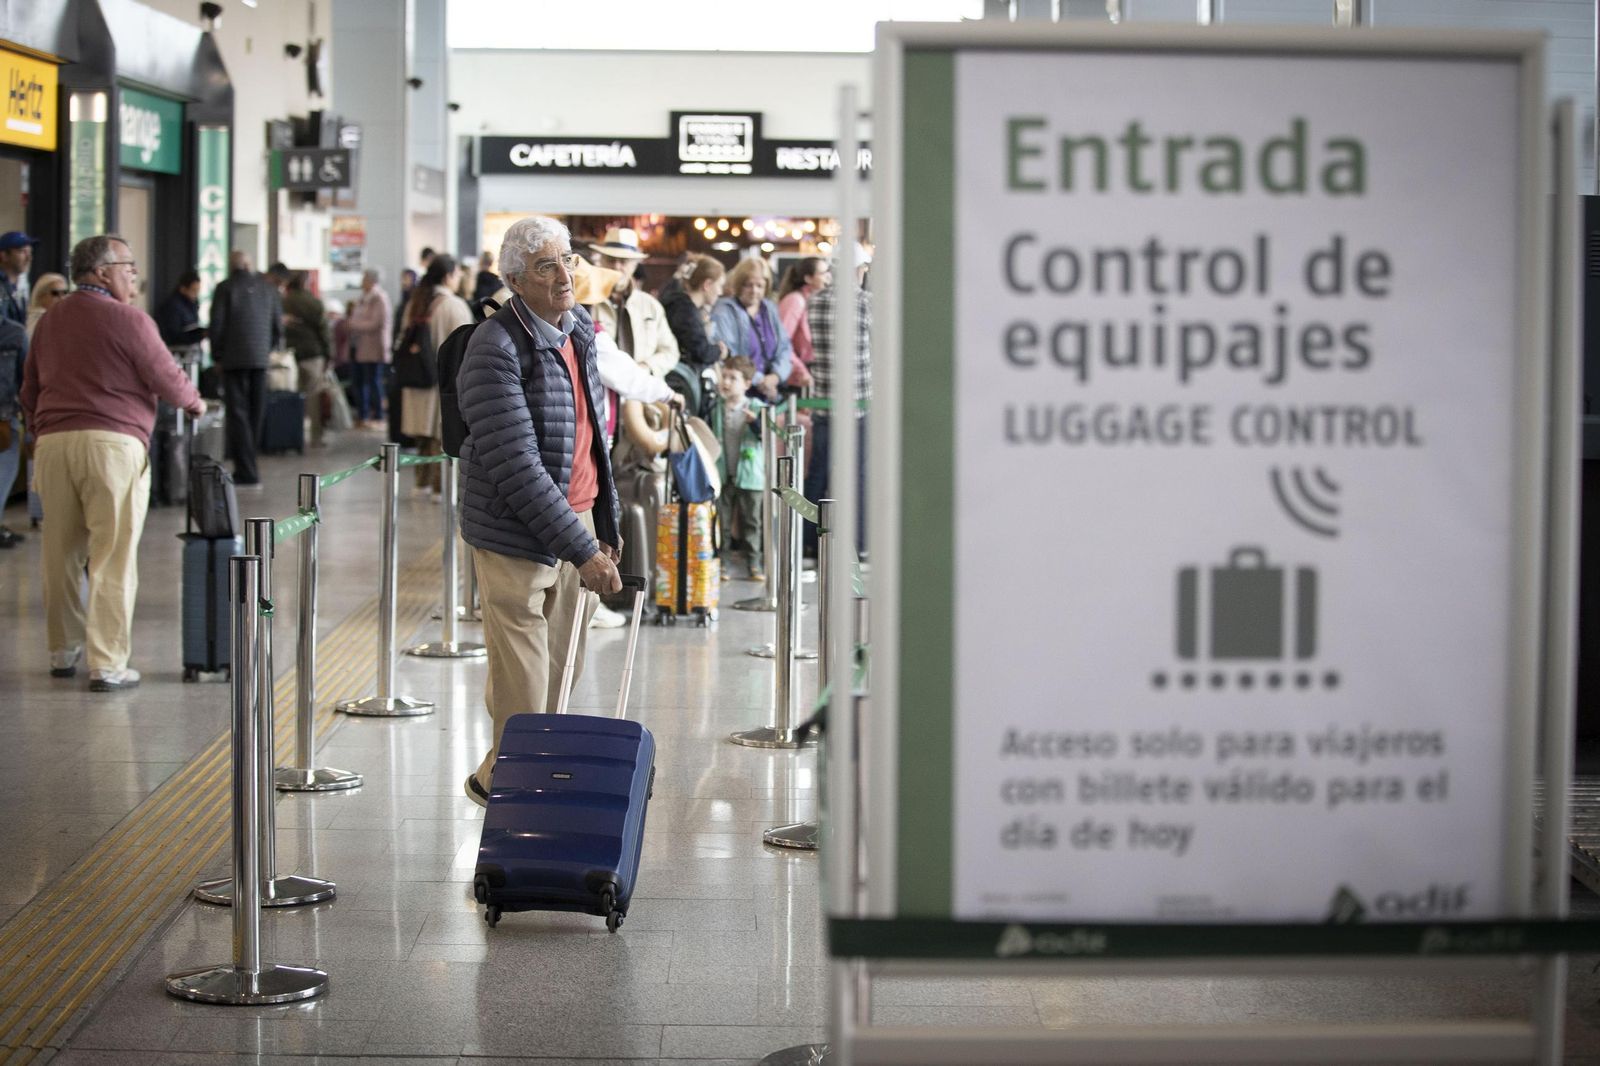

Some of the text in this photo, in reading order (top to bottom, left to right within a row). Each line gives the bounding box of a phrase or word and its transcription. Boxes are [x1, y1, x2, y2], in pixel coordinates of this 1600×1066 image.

[8, 67, 43, 119] Hertz
[509, 140, 637, 167] CAFETERÍA
[1007, 116, 1367, 195] Entrada
[1004, 232, 1393, 298] Control de
[1003, 303, 1372, 386] equipajes
[1004, 404, 1424, 447] LUGGAGE CONTROL
[1001, 725, 1446, 763] Acceso solo para viajeros
[1001, 769, 1450, 810] con billete válido para el
[1000, 817, 1194, 856] día de hoy
